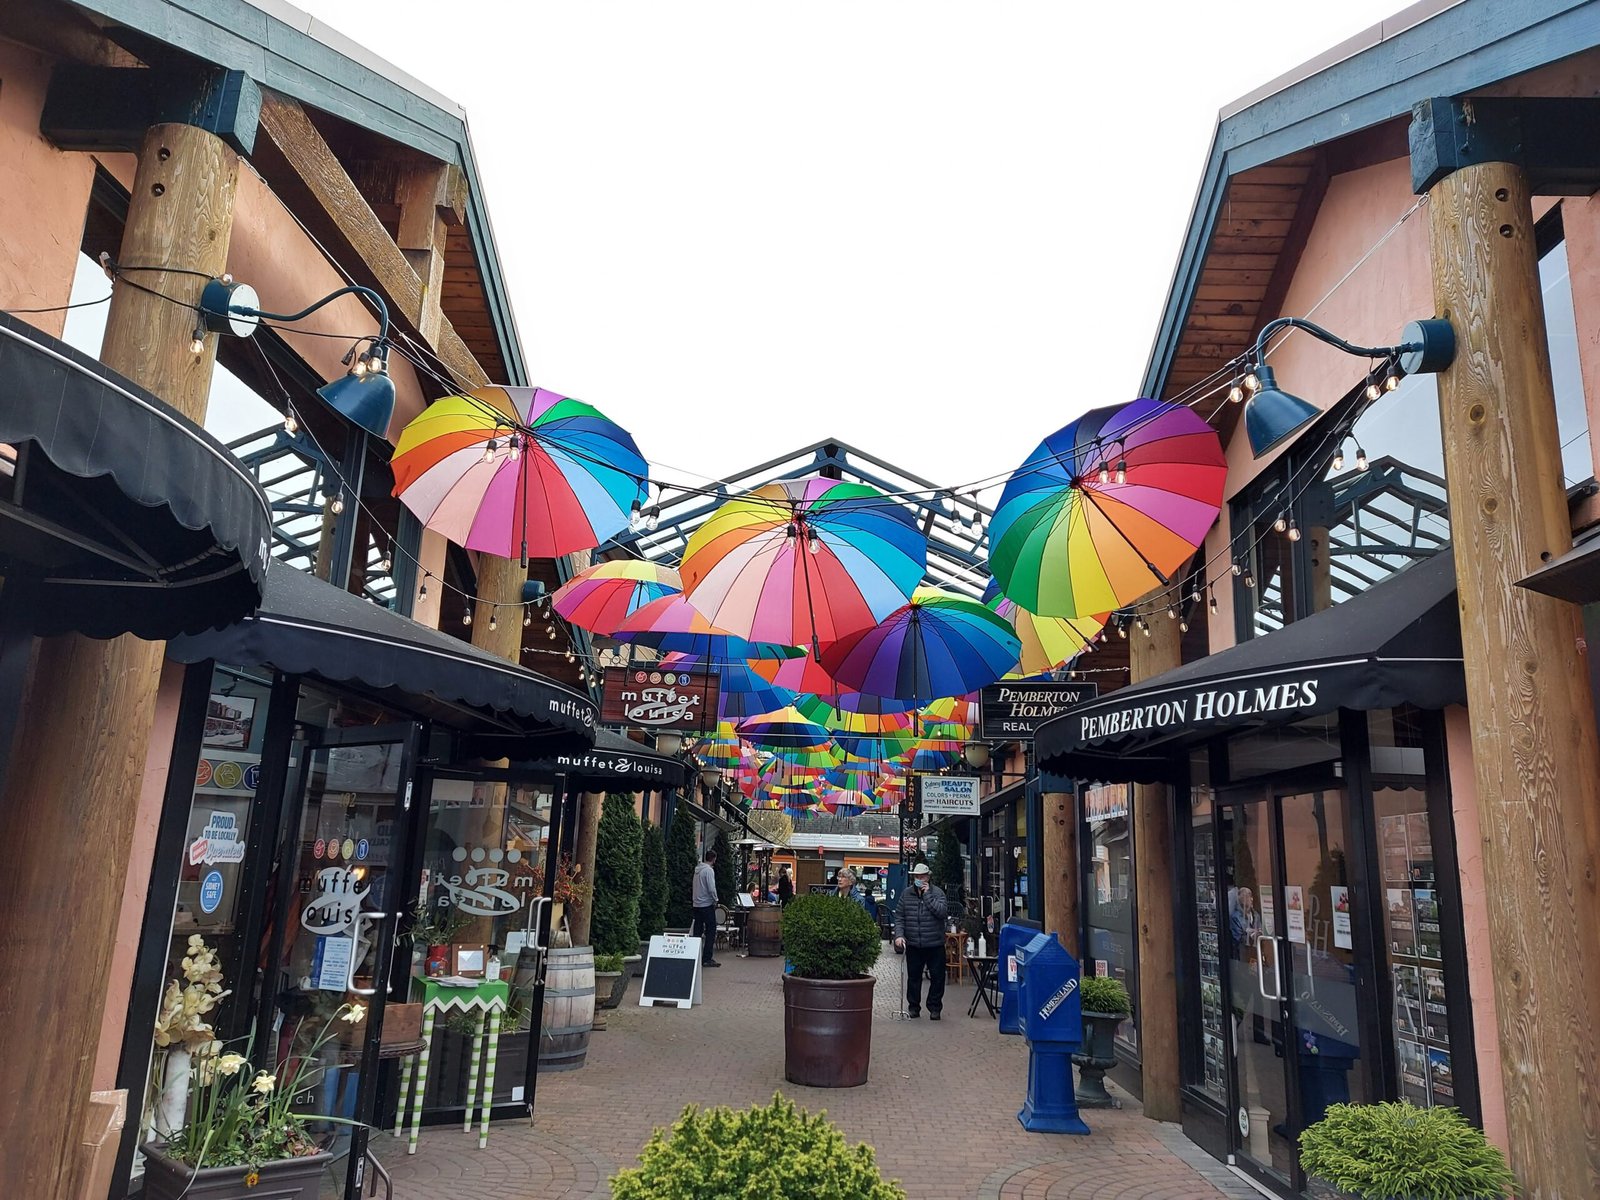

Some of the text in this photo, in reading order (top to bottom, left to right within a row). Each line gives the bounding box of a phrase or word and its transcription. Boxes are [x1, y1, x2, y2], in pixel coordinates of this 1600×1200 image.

[997, 688, 1081, 703] PEMBERTON
[549, 699, 584, 721] muffet
[624, 703, 694, 721] louisa
[1009, 702, 1067, 718] HOLME
[1080, 679, 1319, 741] PEMBERTON HOLMES
[1003, 722, 1034, 732] REAL
[557, 755, 613, 770] muffet
[633, 761, 663, 775] louisa
[211, 815, 234, 829] PROUD
[218, 831, 237, 840] LOCALLY
